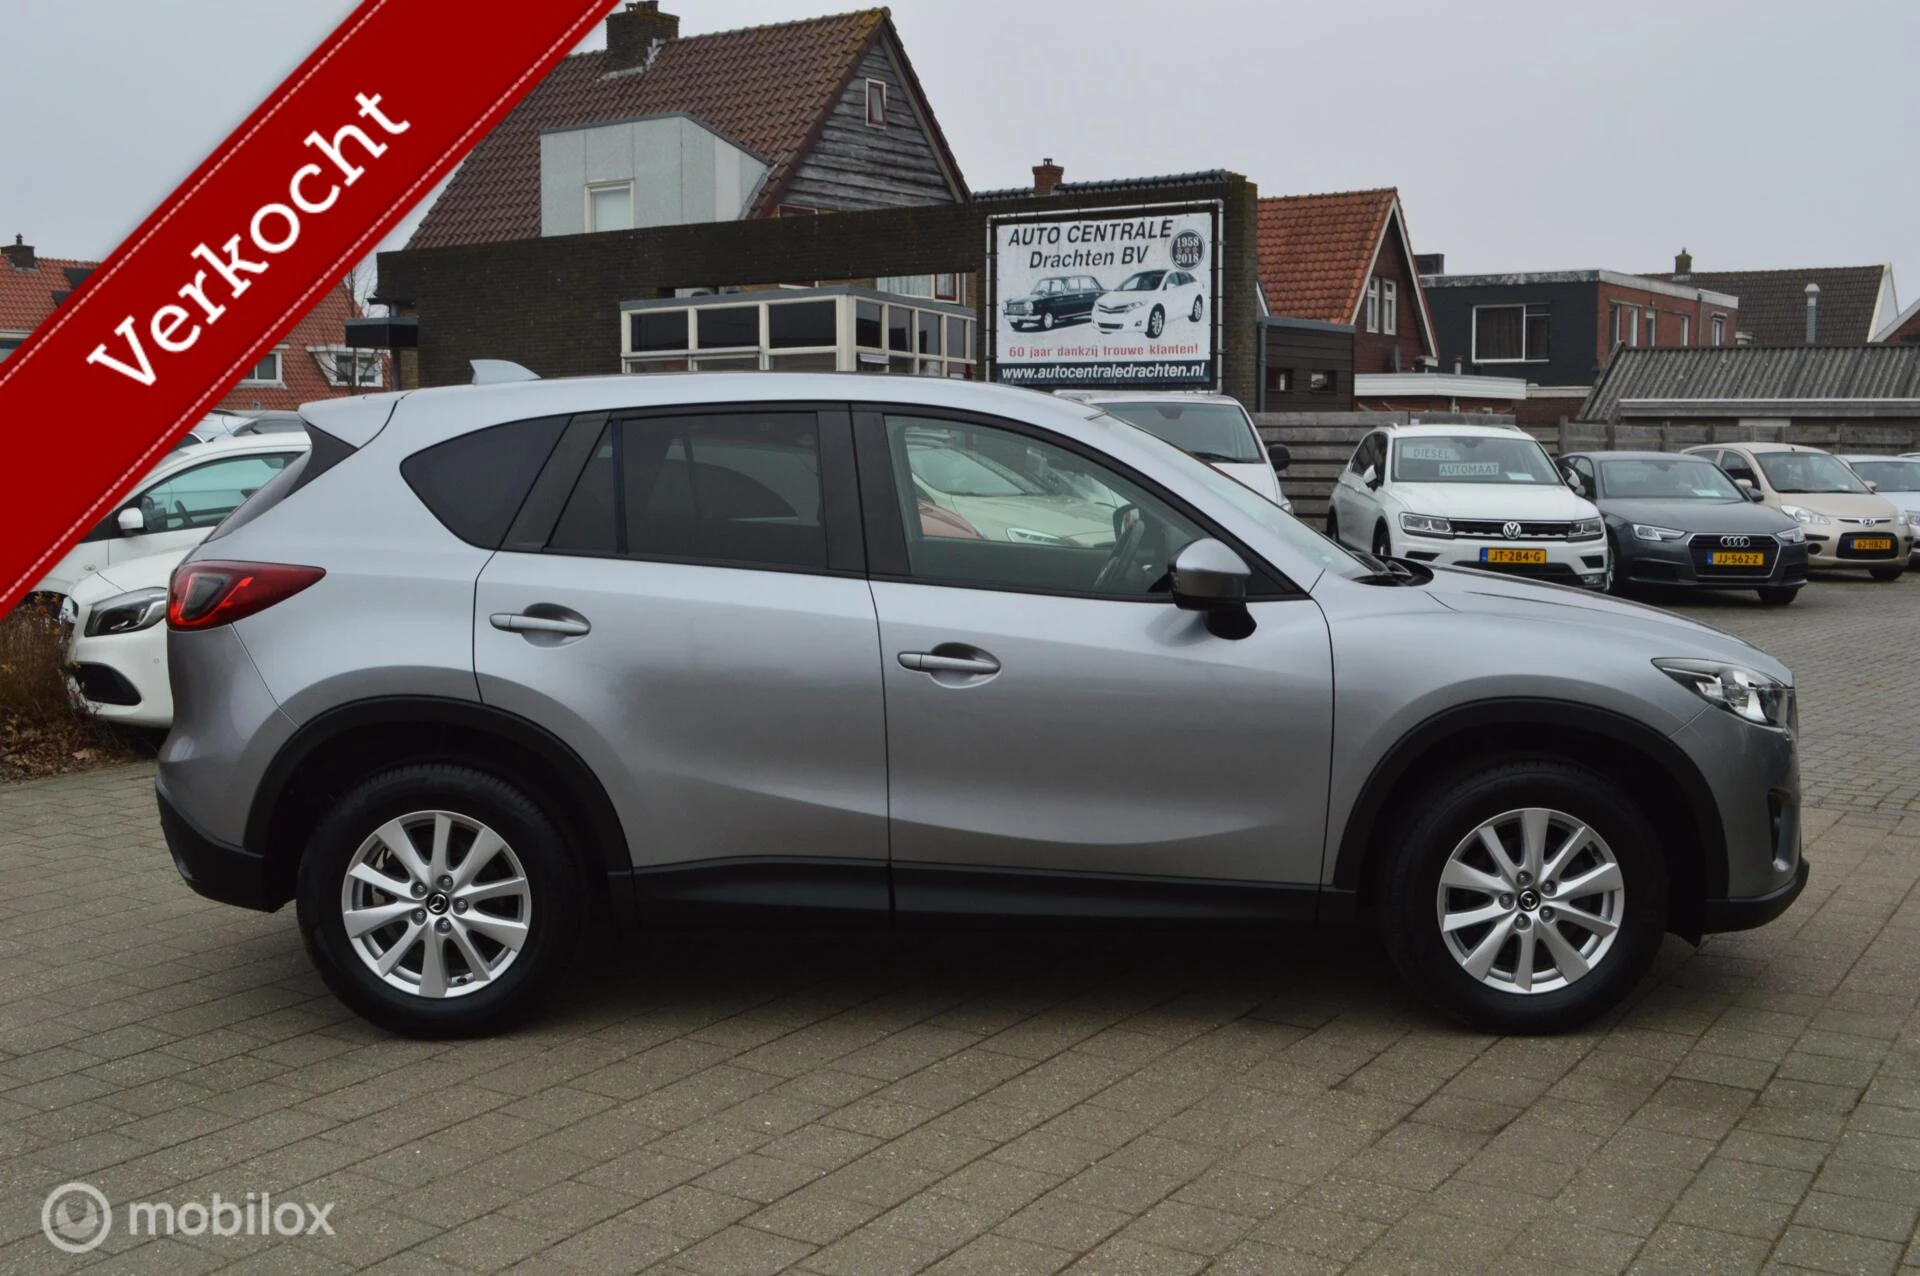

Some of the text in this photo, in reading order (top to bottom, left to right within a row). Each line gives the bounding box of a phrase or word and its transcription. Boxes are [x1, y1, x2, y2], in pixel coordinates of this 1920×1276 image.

[1008, 219, 1174, 247] AUTO CENTRALE
[1177, 236, 1200, 248] 1958
[1029, 245, 1149, 269] Drachten BV
[1175, 252, 1199, 265] 2018
[1009, 343, 1199, 359] 60 jaar dankzij trouwe klanten!
[1002, 362, 1205, 379] www.autocentraledrachten.nl
[1413, 447, 1450, 459] DIESEL
[1440, 462, 1498, 474] AUTOMAAT
